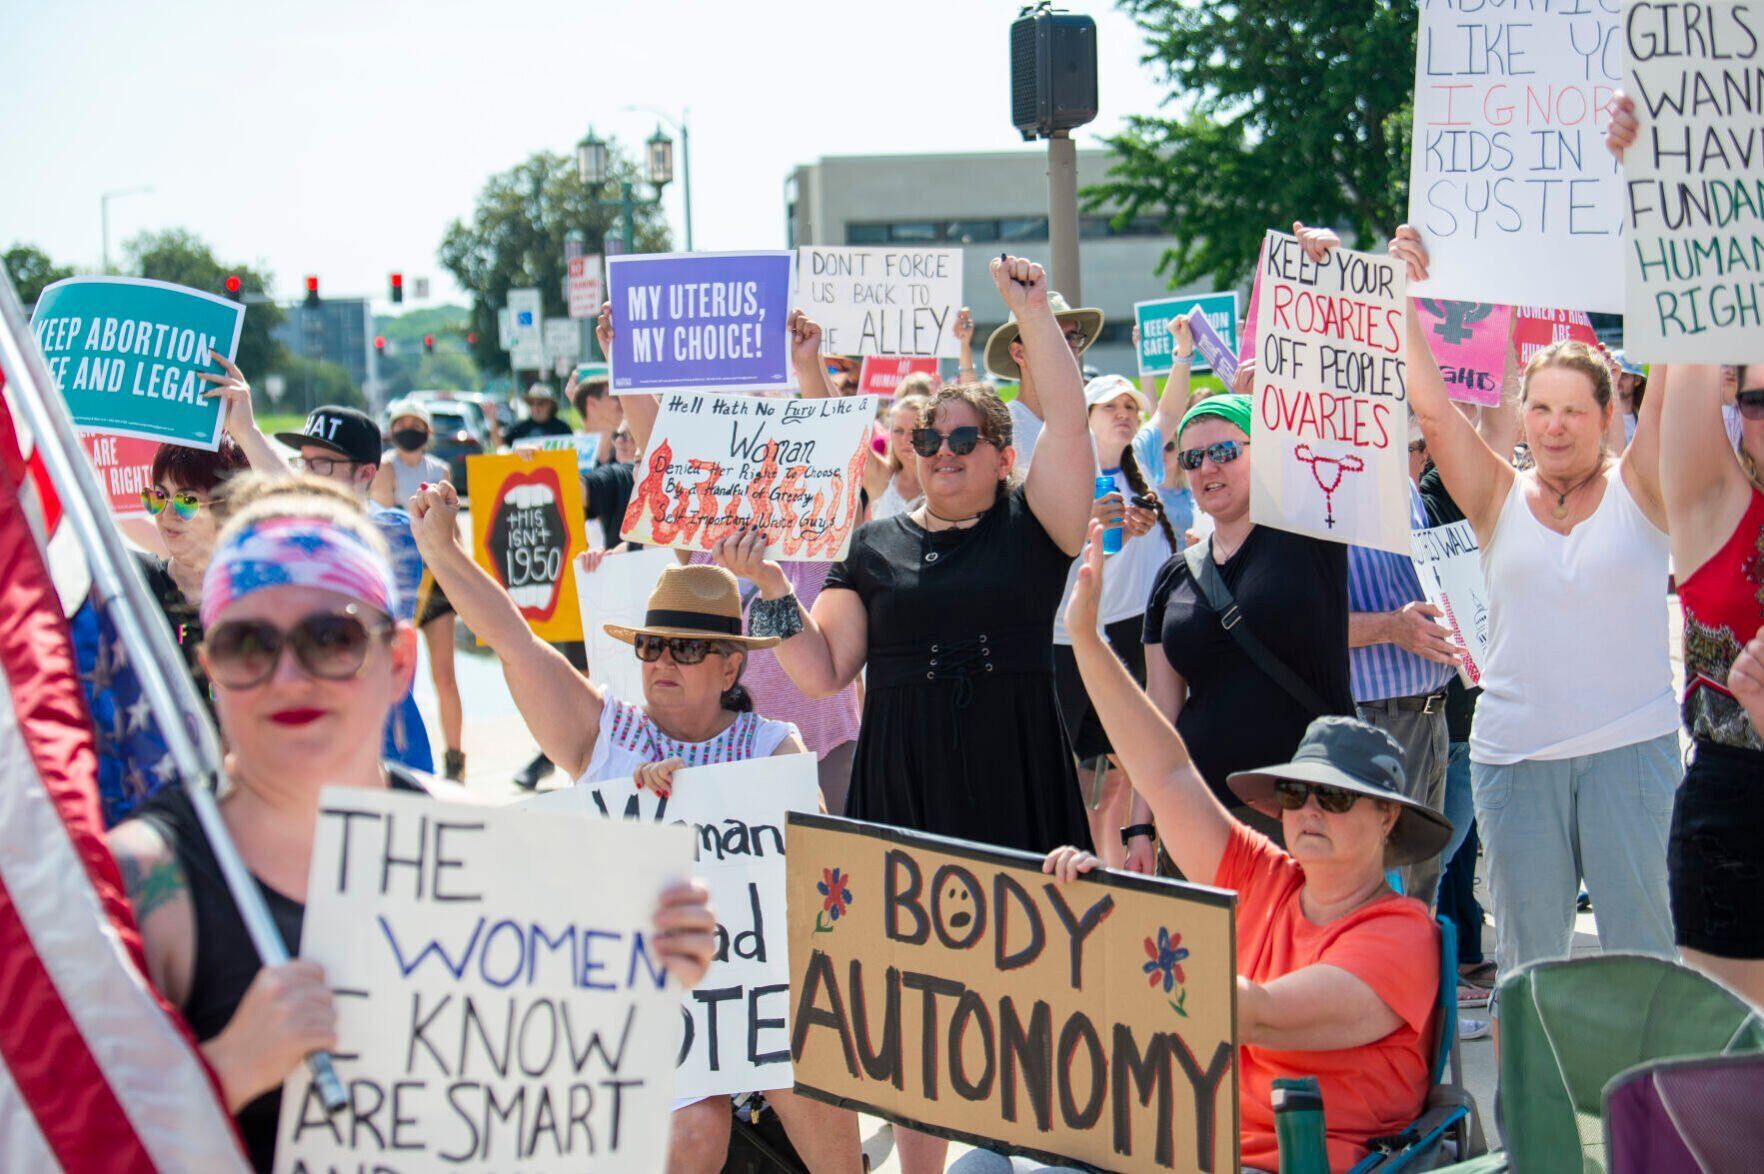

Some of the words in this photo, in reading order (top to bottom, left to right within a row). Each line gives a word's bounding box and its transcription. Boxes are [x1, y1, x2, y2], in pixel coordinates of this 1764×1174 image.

[1427, 23, 1536, 76] LIKE
[1570, 20, 1622, 81] YO
[1626, 2, 1758, 62] GIRLS
[1427, 85, 1615, 126] IGNOR
[1425, 130, 1514, 173] KIDS
[1529, 130, 1582, 172] IN
[1651, 125, 1764, 175] HAV
[1426, 177, 1623, 240] SYSTE
[812, 251, 872, 277] DONT
[885, 253, 950, 279] FORCE
[1267, 235, 1332, 286] KEEP
[1336, 252, 1394, 300] YOUR
[628, 285, 662, 321] MY
[669, 281, 766, 322] UTERUS,
[812, 281, 836, 304] US
[853, 282, 896, 305] BACK
[907, 284, 931, 306] TO
[1655, 283, 1764, 337] RIGH
[34, 317, 82, 352] KEEP
[84, 317, 217, 368] ABORTION
[632, 327, 665, 363] MY
[673, 323, 763, 362] CHOICE!
[819, 327, 839, 355] HE
[858, 305, 950, 356] ALLEY
[1273, 285, 1402, 353] ROSARIES
[1143, 336, 1171, 356] SAFE
[1264, 333, 1307, 380] OFF
[72, 357, 125, 393] AND
[132, 361, 210, 408] LEGAL
[1439, 366, 1496, 392] GHTS
[668, 395, 703, 414] Hell
[712, 398, 748, 416] Hath
[755, 402, 775, 416] No
[783, 400, 817, 420] Fury
[858, 398, 868, 411] a
[1262, 384, 1390, 449] OVARIES
[93, 438, 119, 467] ARE
[655, 455, 701, 475] Denied
[730, 420, 816, 465] Woman
[109, 464, 154, 496] RIGHT
[665, 477, 684, 499] By
[688, 485, 697, 496] a
[751, 487, 764, 499] of
[1434, 524, 1479, 559] WALL
[506, 546, 561, 586] 1950
[320, 808, 485, 902] THE
[884, 848, 1115, 992] BODY
[377, 914, 669, 991] WOMEN
[405, 990, 636, 1078] KNOW
[675, 985, 792, 1072] TE
[791, 948, 1233, 1174] AUTONOMY
[293, 1078, 426, 1150] ARE
[437, 1079, 644, 1163] SMART
